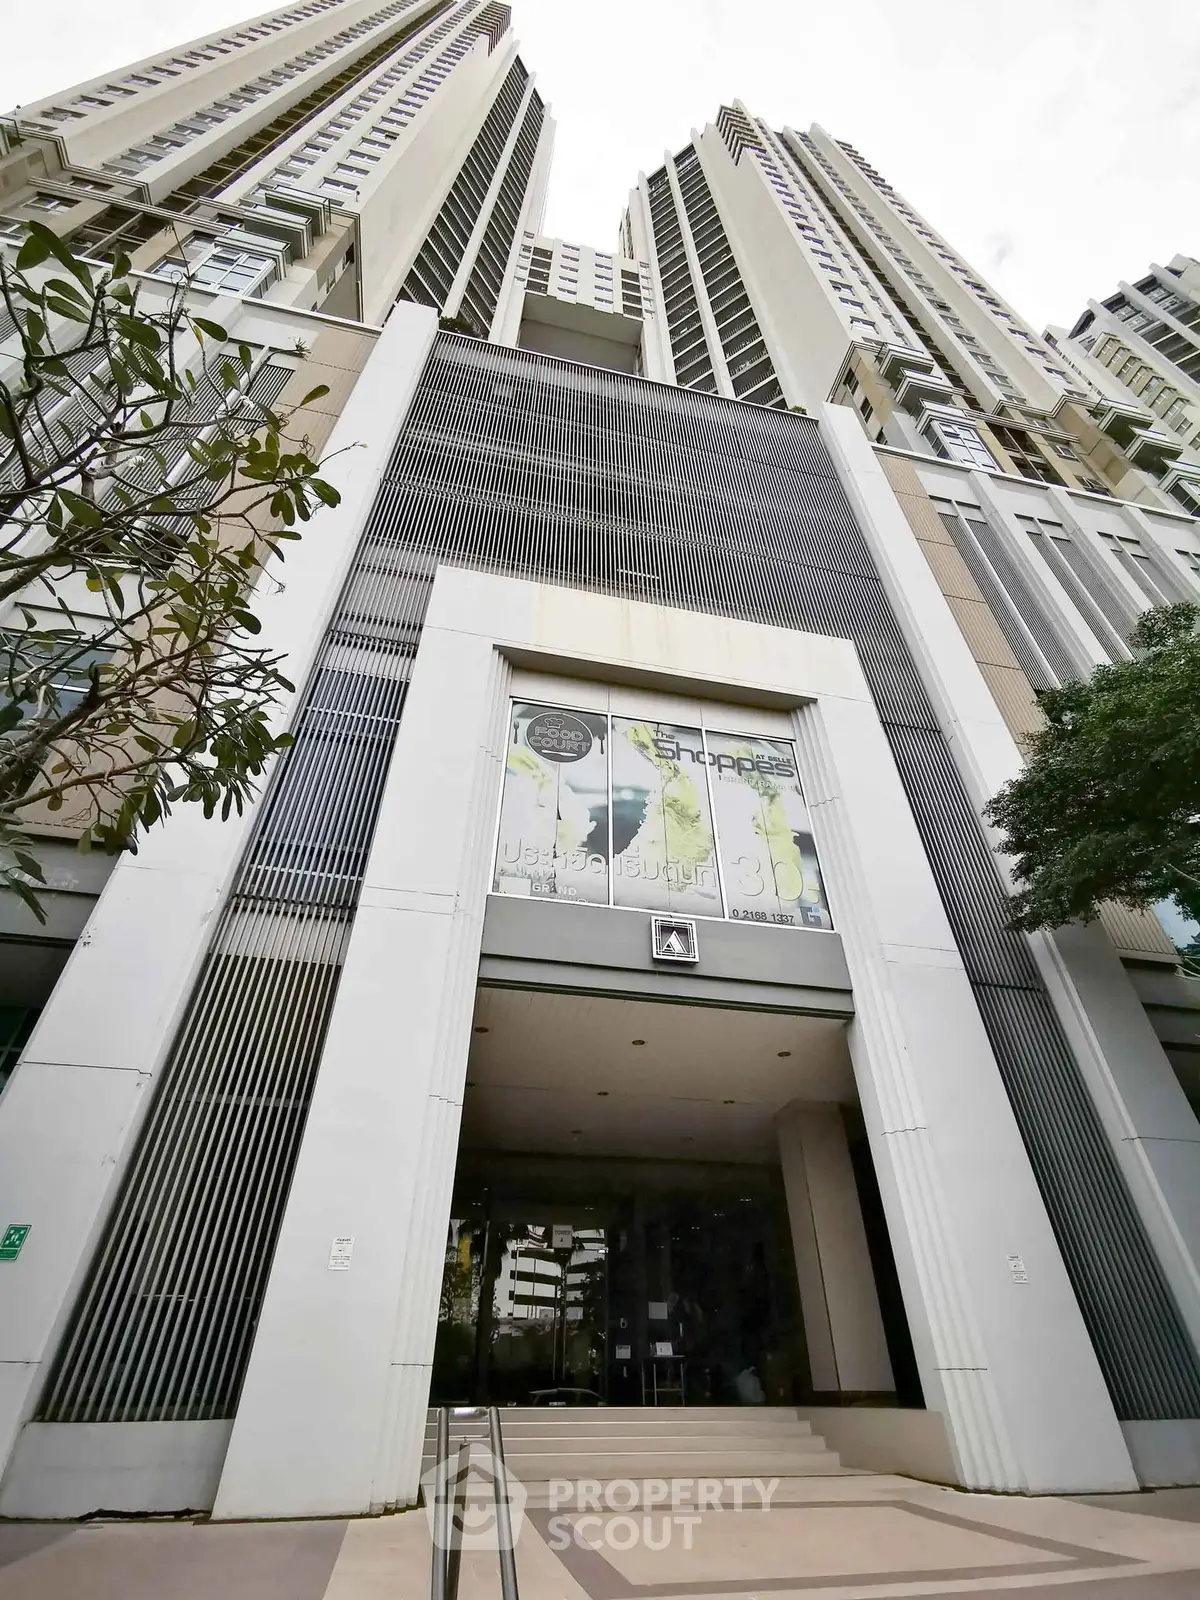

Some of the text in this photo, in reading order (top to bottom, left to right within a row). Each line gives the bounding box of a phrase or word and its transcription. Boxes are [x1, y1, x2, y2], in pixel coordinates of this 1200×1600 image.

[534, 726, 584, 741] FOOD
[652, 730, 675, 740] The
[529, 736, 590, 751] COURT
[651, 738, 795, 778] Shoppes
[732, 909, 794, 922] 0 2168 1337
